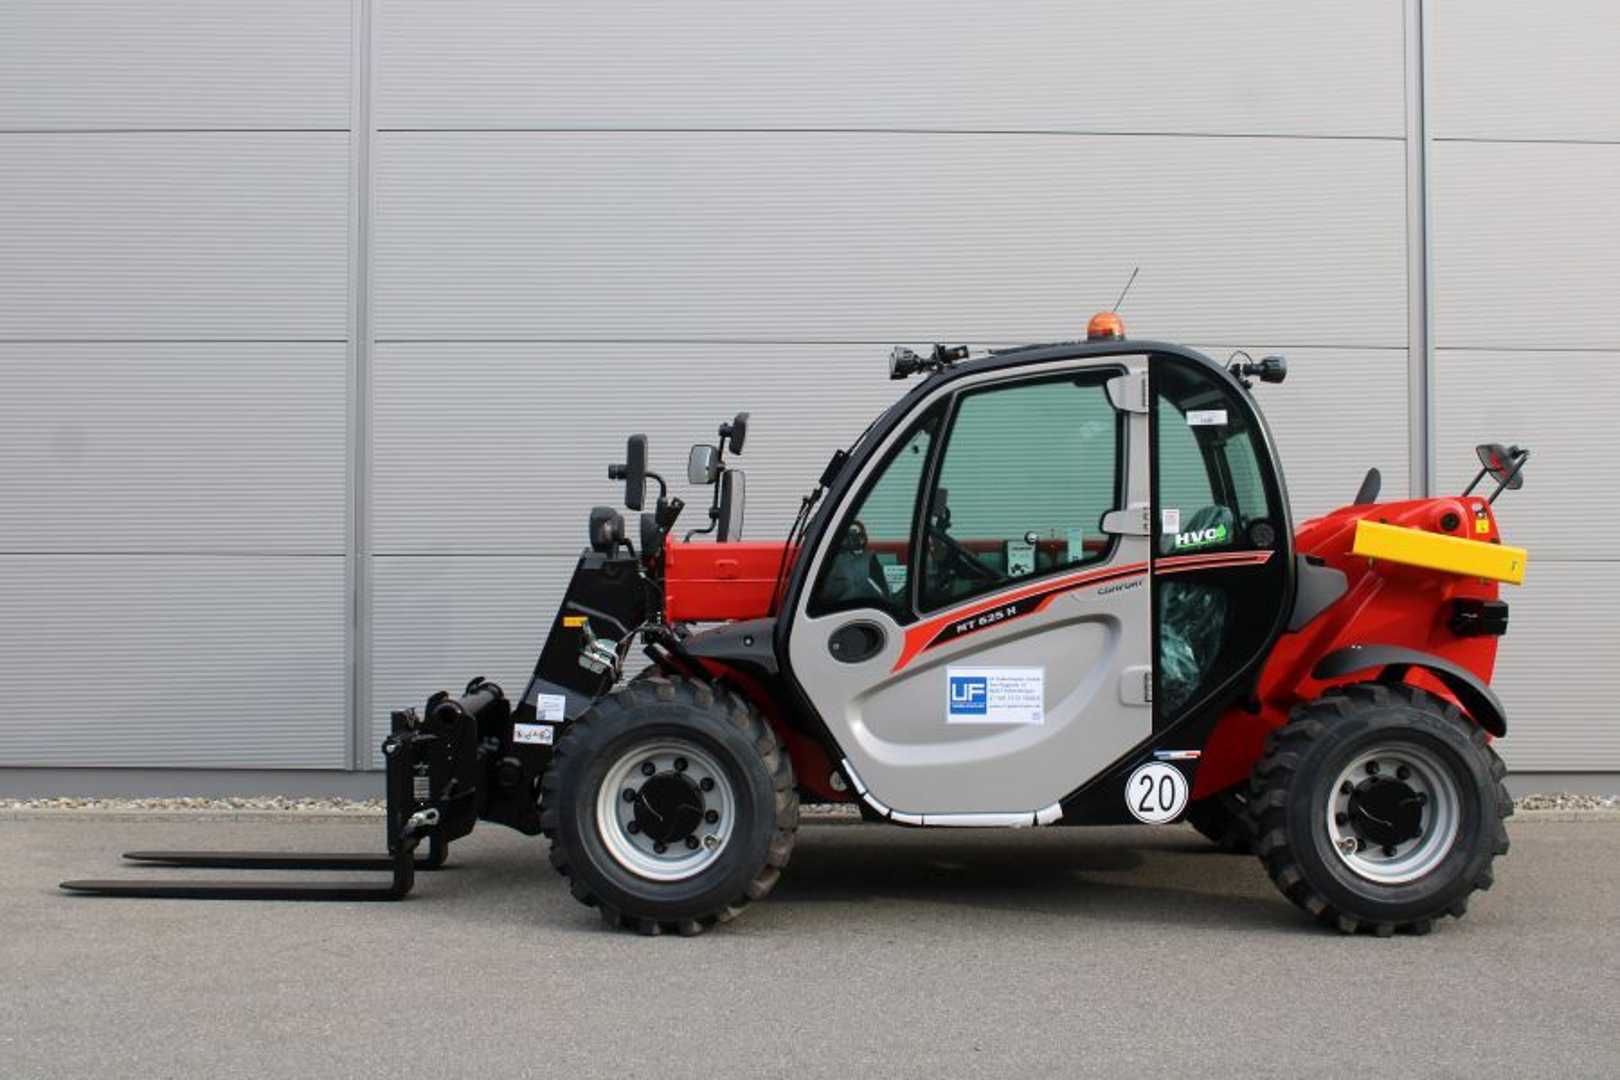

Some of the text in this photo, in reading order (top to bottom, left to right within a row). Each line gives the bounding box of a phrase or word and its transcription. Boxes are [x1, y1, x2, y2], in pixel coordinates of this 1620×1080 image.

[957, 606, 1016, 633] MT 625 H
[952, 683, 985, 701] UF
[1139, 774, 1175, 812] 20
